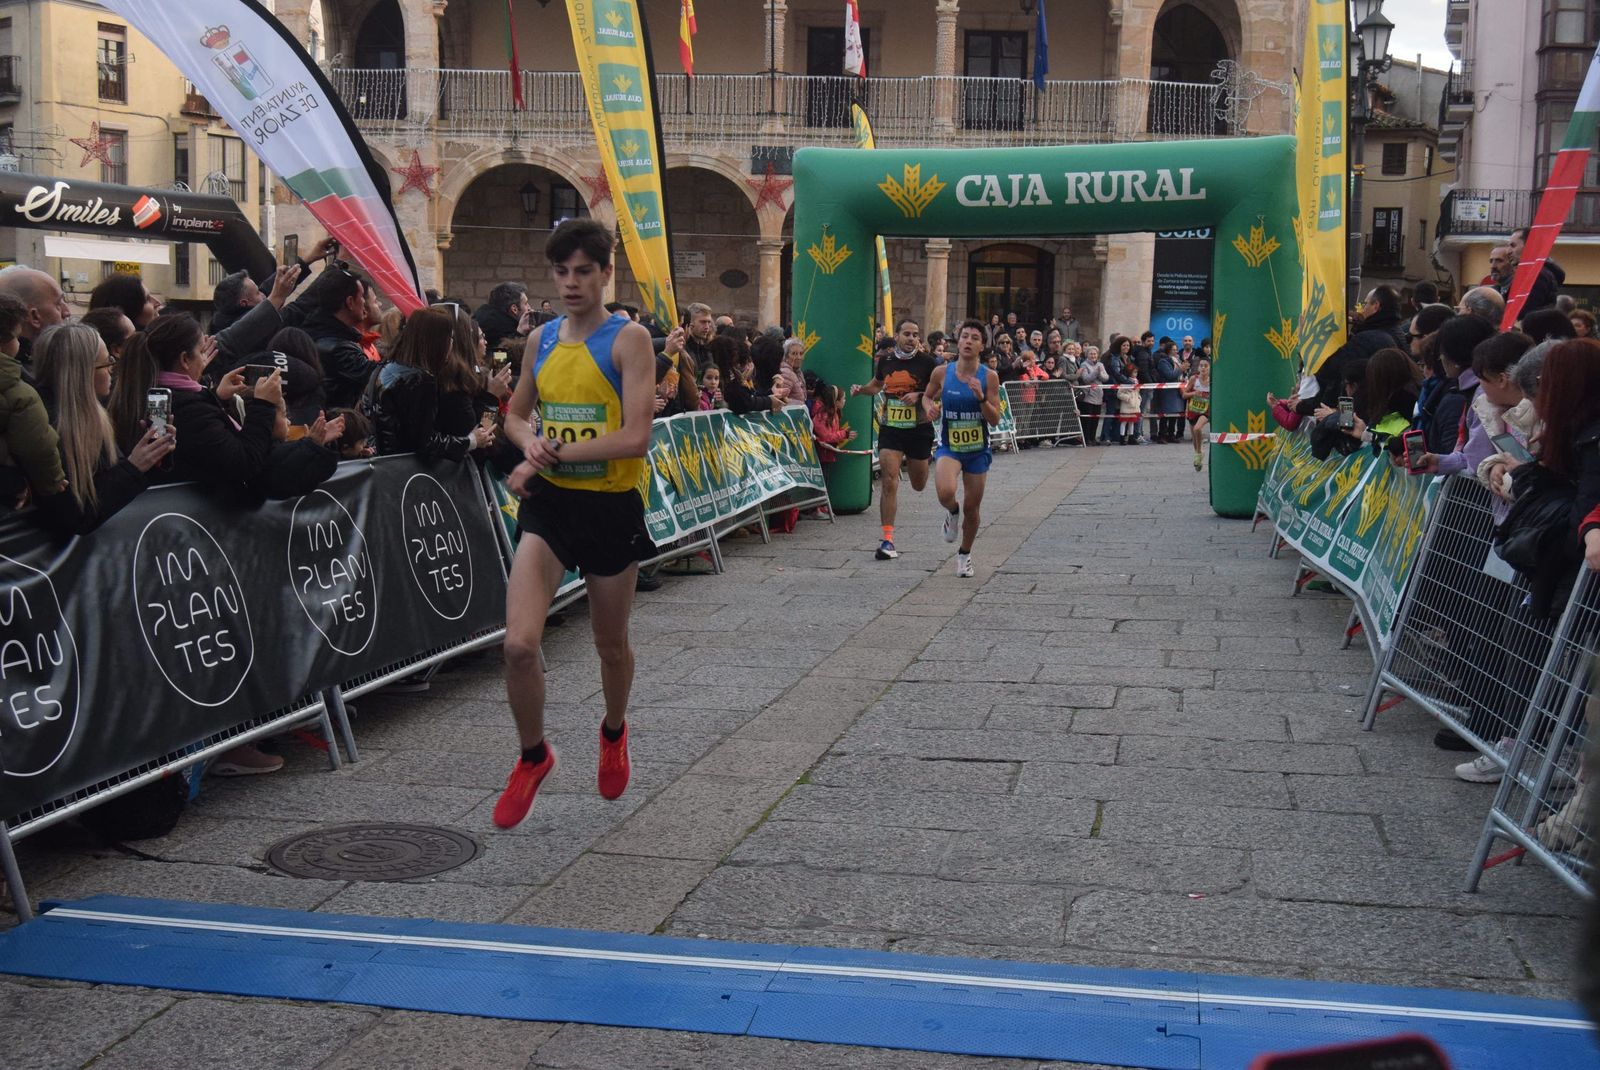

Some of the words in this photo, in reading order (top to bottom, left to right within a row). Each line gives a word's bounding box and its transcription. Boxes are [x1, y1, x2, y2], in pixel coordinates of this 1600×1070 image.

[15, 181, 122, 226] Smiles
[956, 174, 1053, 209] CAJA
[1065, 168, 1207, 205] RURAL
[173, 204, 182, 214] by
[1166, 317, 1194, 331] 016
[891, 408, 912, 420] 770
[953, 429, 980, 444] 909
[414, 501, 445, 527] IM
[307, 520, 343, 551] IM
[156, 548, 209, 586] IM
[429, 564, 464, 593] TES
[322, 591, 366, 626] TES
[175, 630, 236, 673] TES
[0, 685, 63, 737] ES
